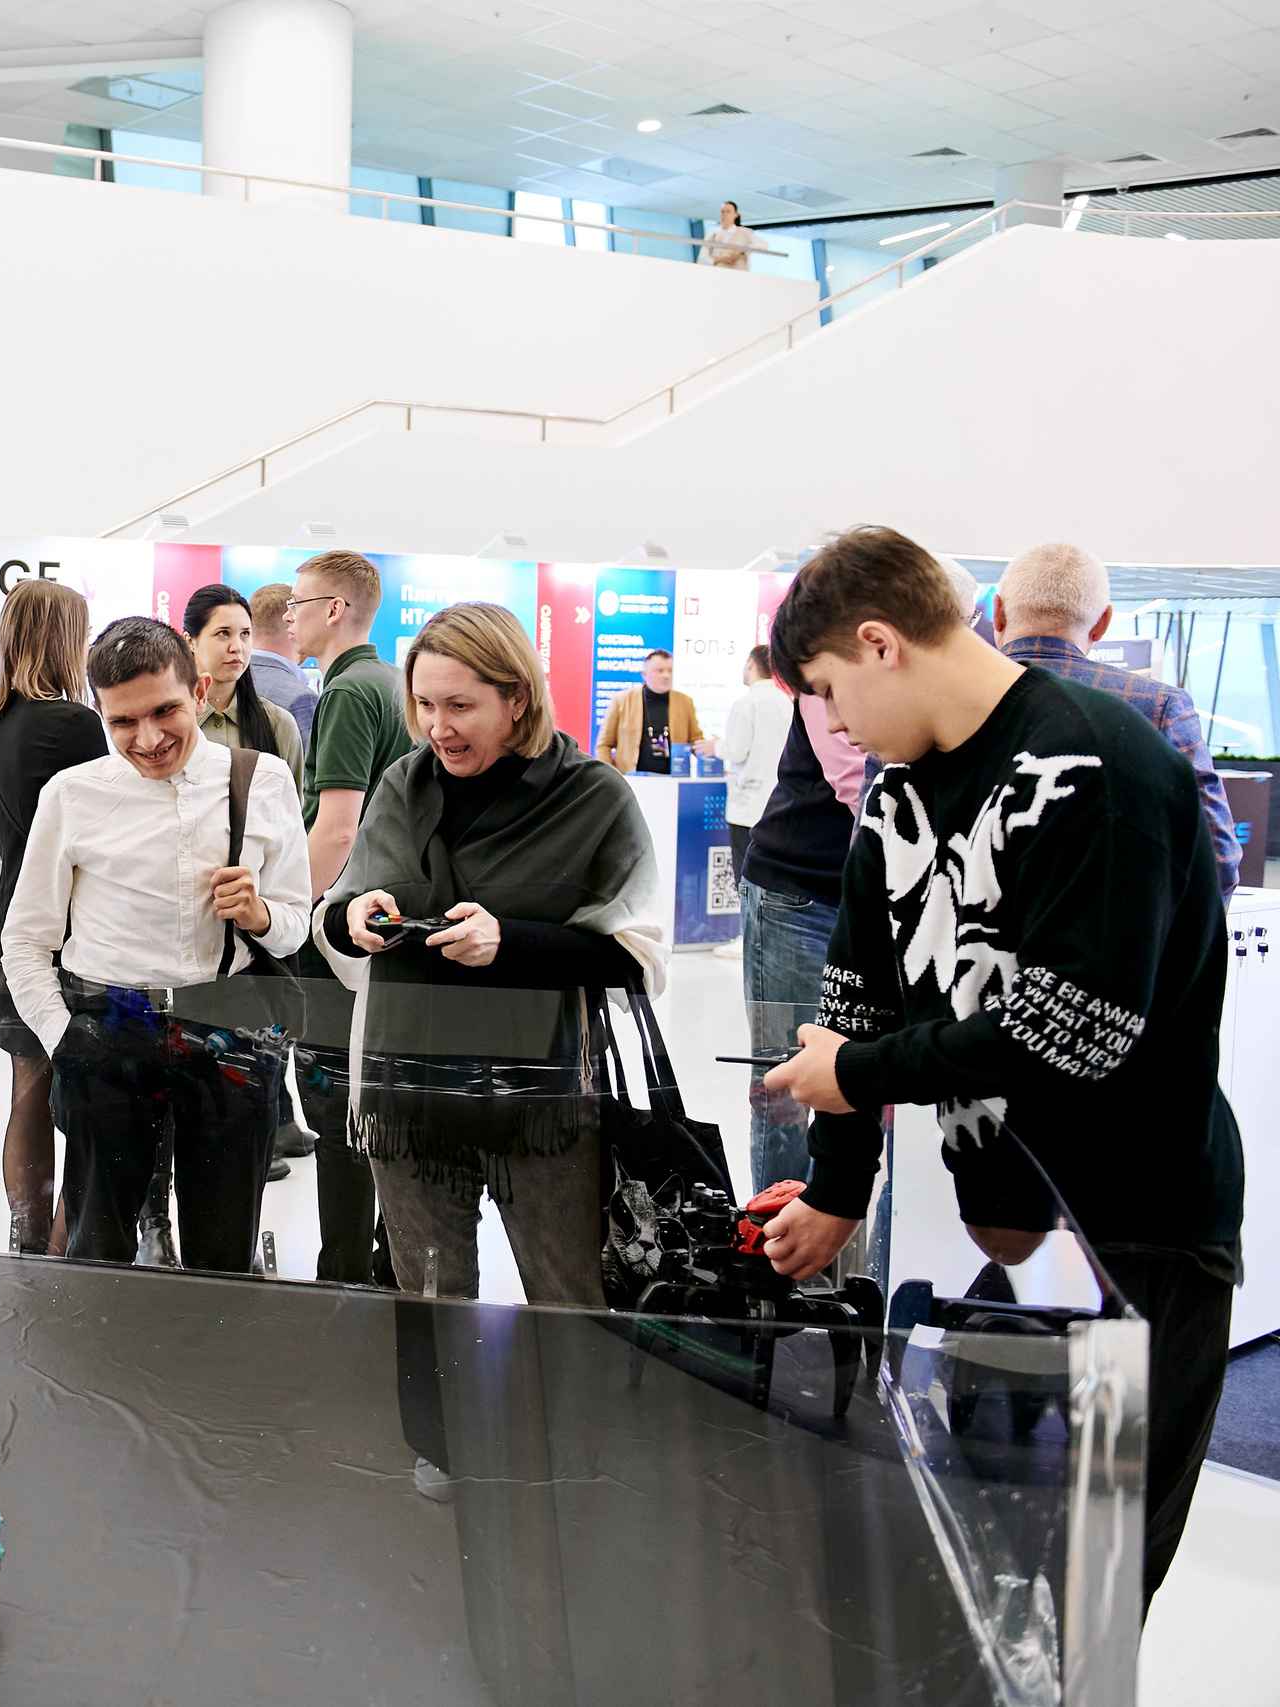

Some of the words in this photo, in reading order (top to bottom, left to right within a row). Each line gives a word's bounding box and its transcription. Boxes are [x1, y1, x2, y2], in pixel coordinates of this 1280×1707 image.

[683, 638, 735, 655] ТОП-3
[1057, 982, 1088, 1007] BE
[1000, 1012, 1048, 1051] YOU
[1024, 982, 1091, 1031] WHAT
[1094, 1022, 1134, 1055] YOU
[1043, 1018, 1072, 1045] TO
